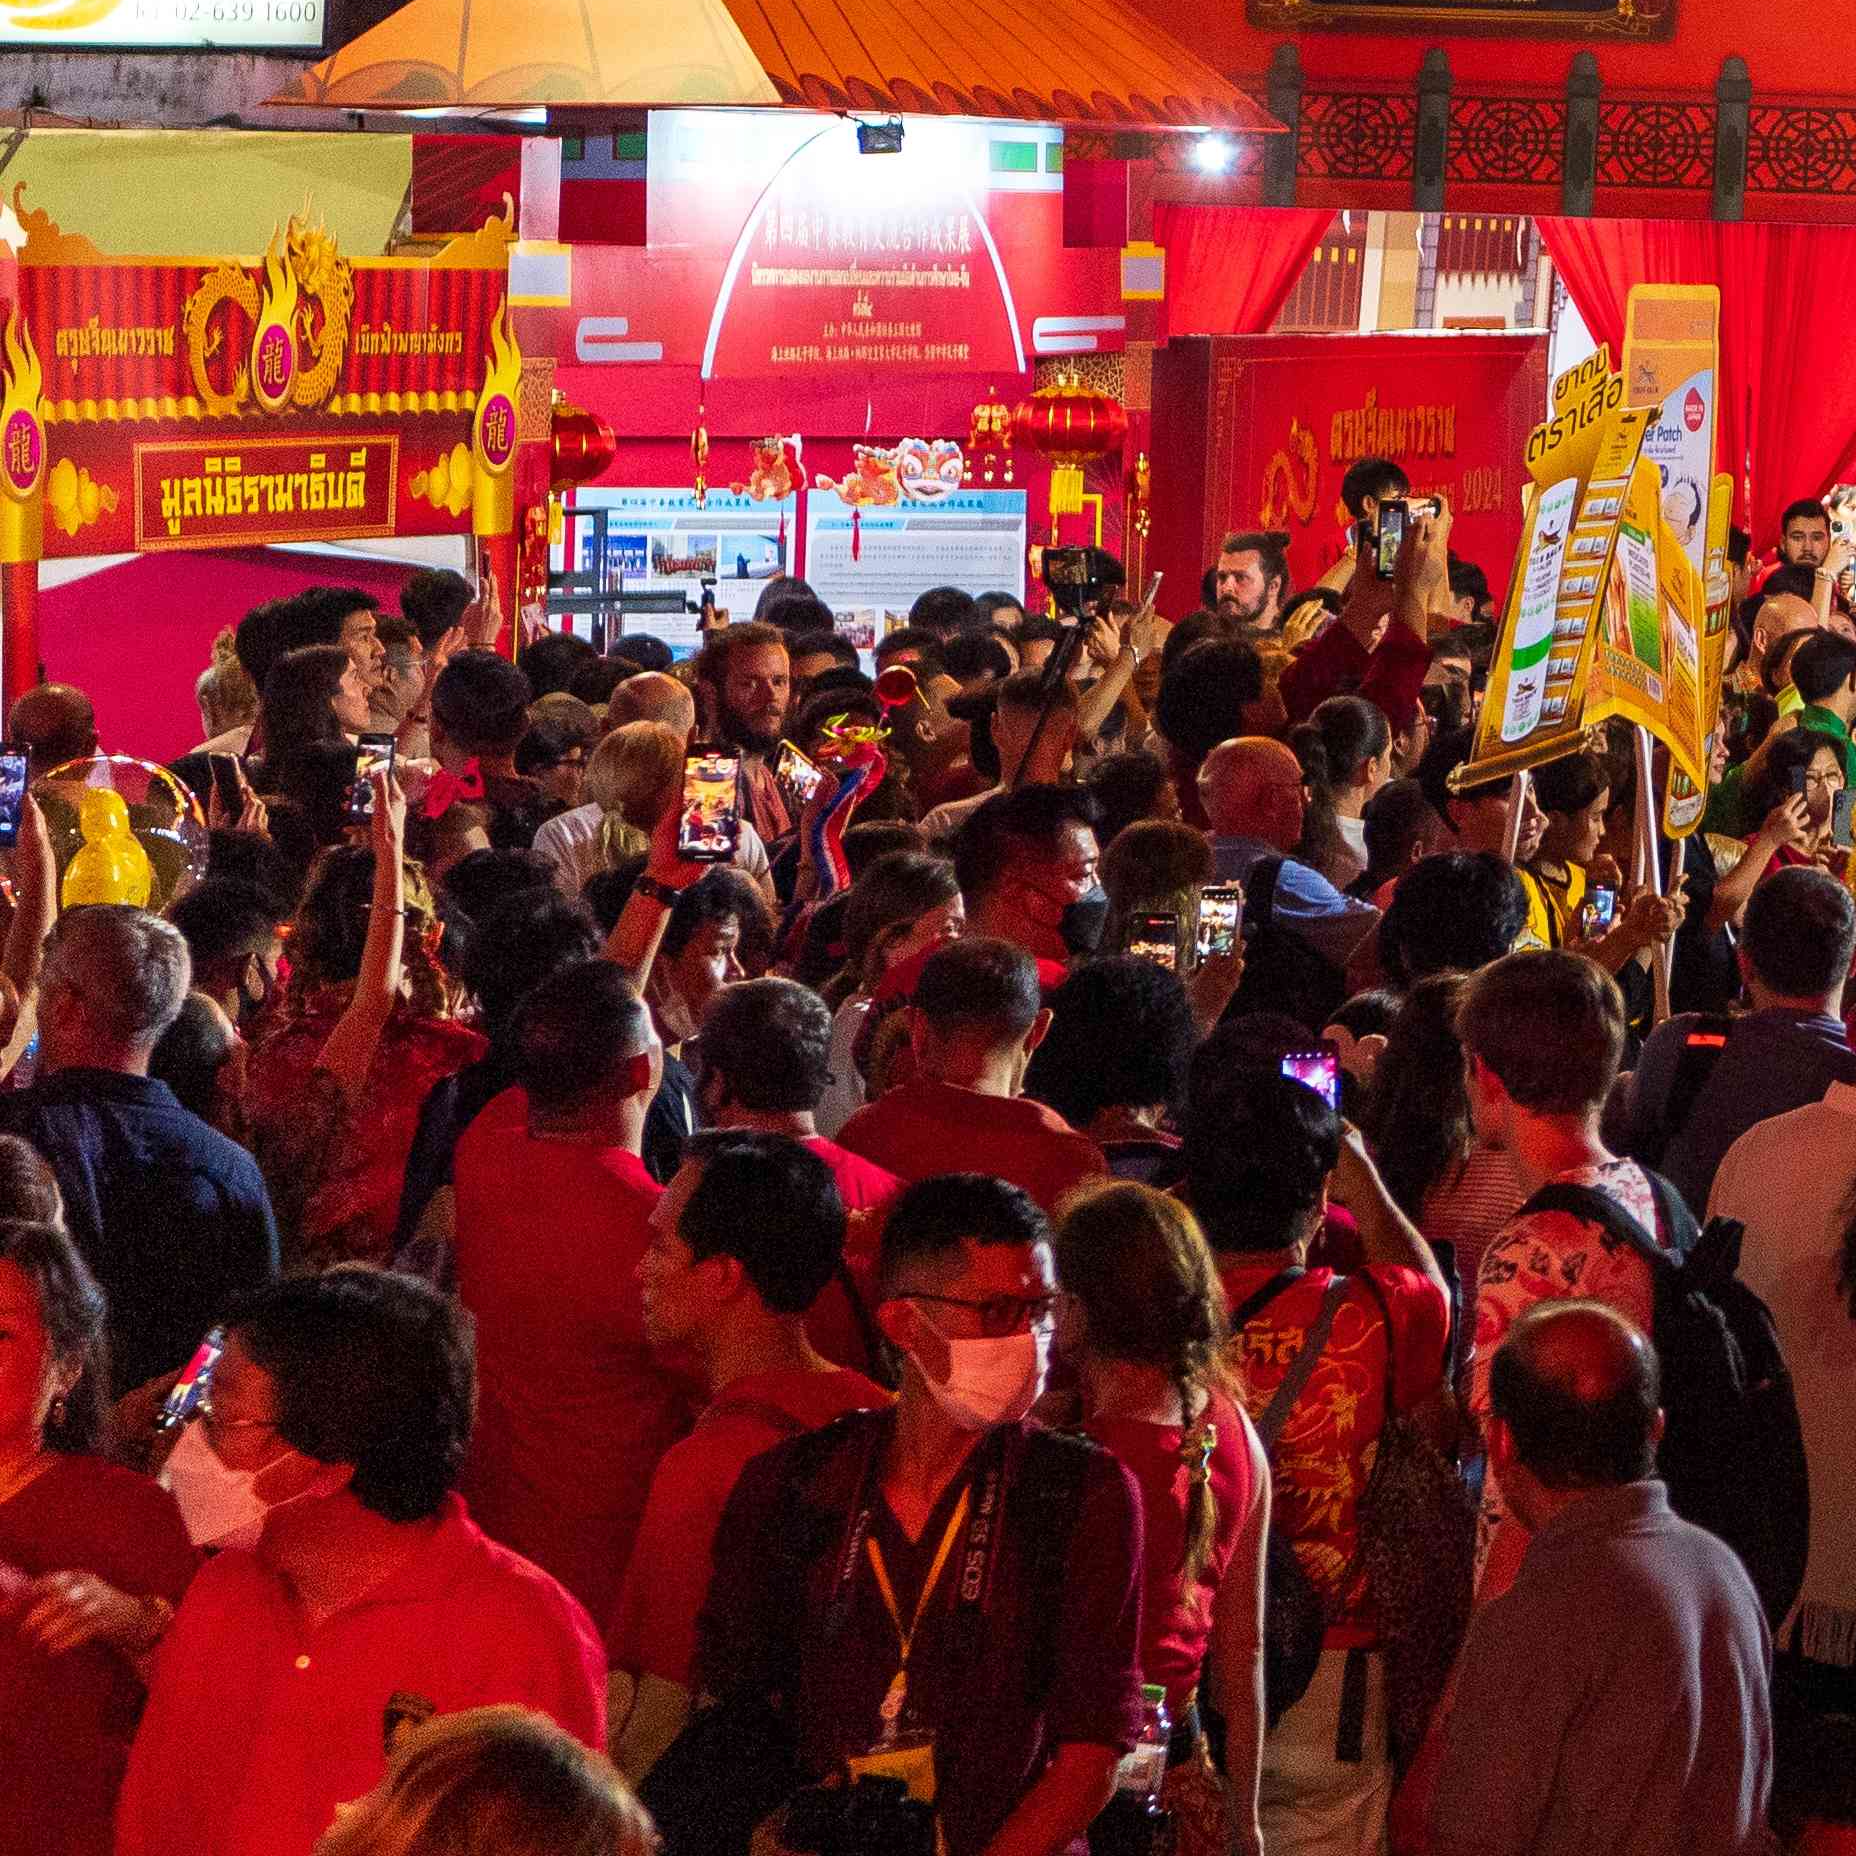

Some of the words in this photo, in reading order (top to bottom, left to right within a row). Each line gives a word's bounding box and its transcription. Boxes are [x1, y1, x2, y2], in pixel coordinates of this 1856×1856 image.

[1554, 347, 1608, 401] ยาดม
[1527, 374, 1624, 463] ตราเสือ
[1657, 426, 1683, 443] Patch
[160, 447, 367, 535] มูลนิธิรามาธิบดี
[960, 1550, 986, 1600] EOS
